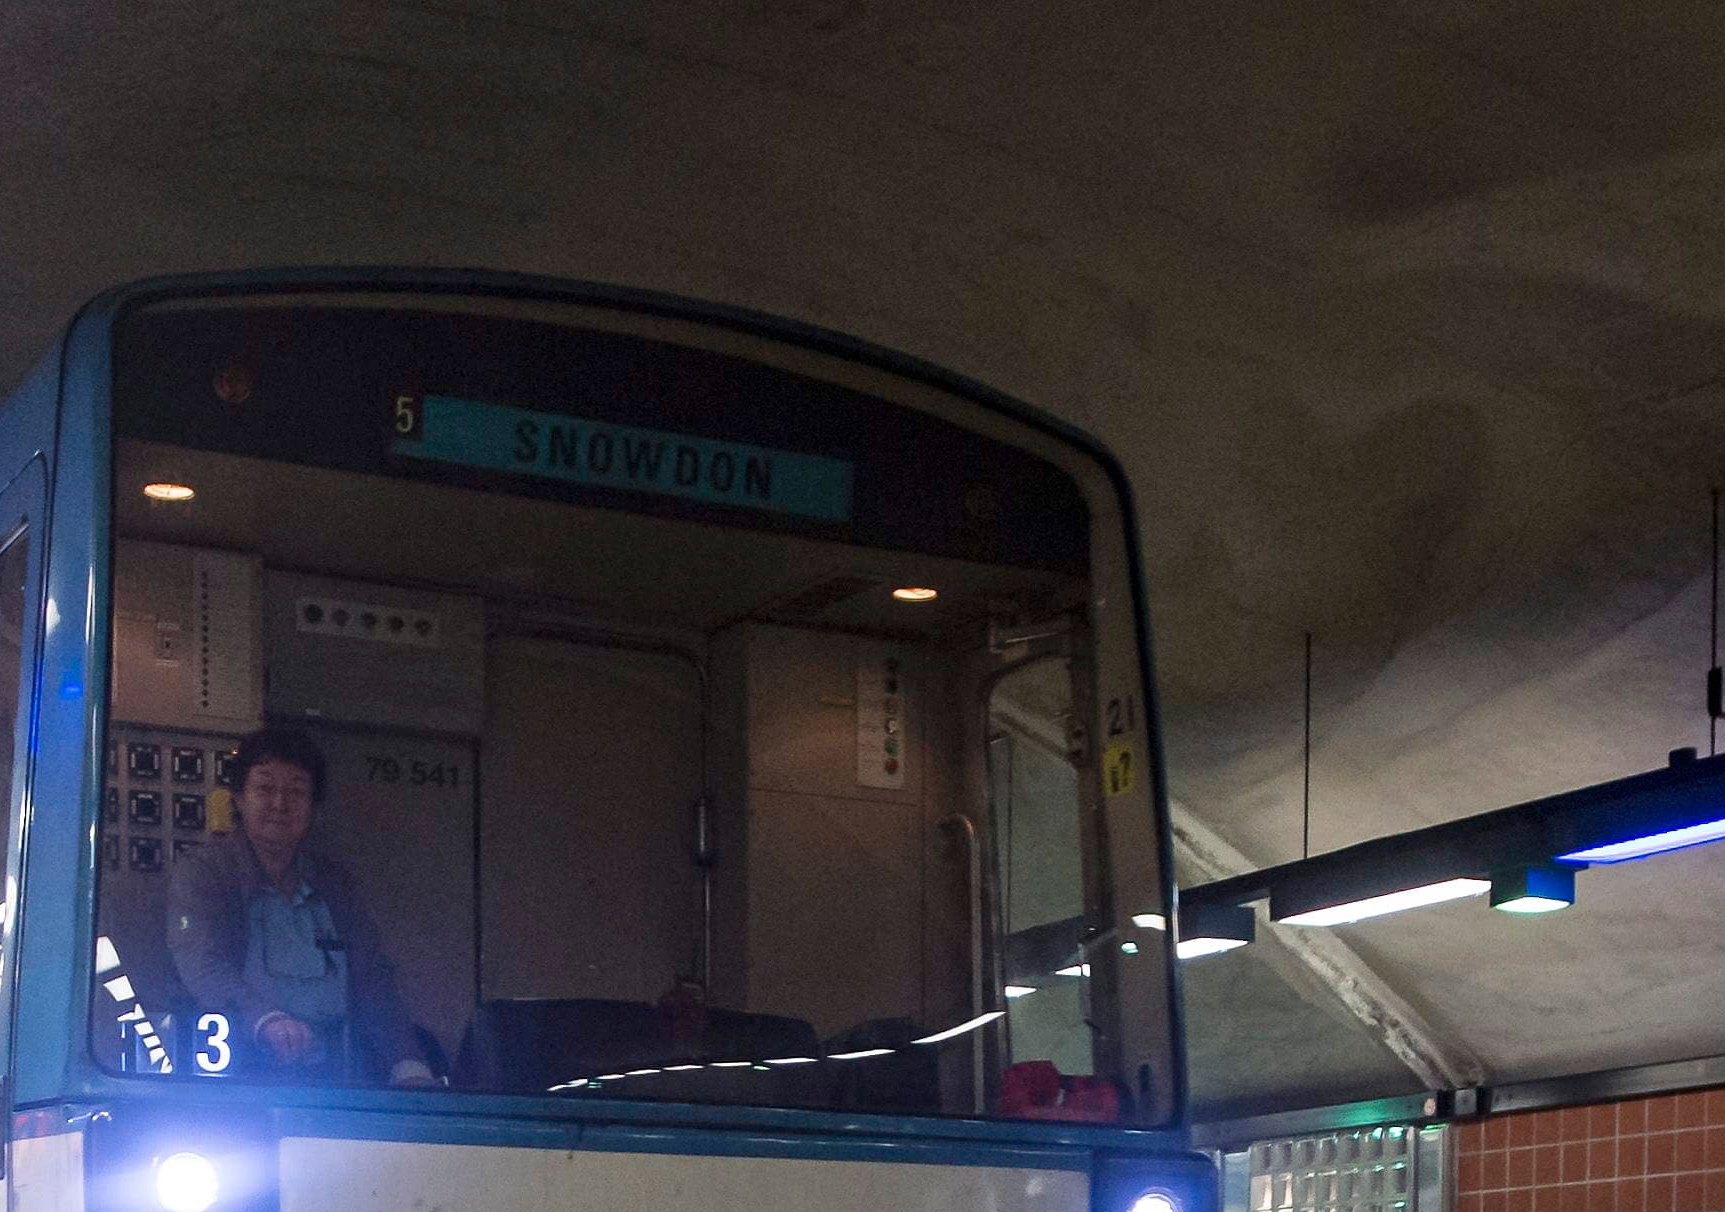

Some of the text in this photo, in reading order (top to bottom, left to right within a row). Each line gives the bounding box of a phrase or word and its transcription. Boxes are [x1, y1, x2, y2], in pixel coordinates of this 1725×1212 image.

[394, 396, 773, 497] 5 SNOWDON
[194, 1012, 232, 1074] 3
